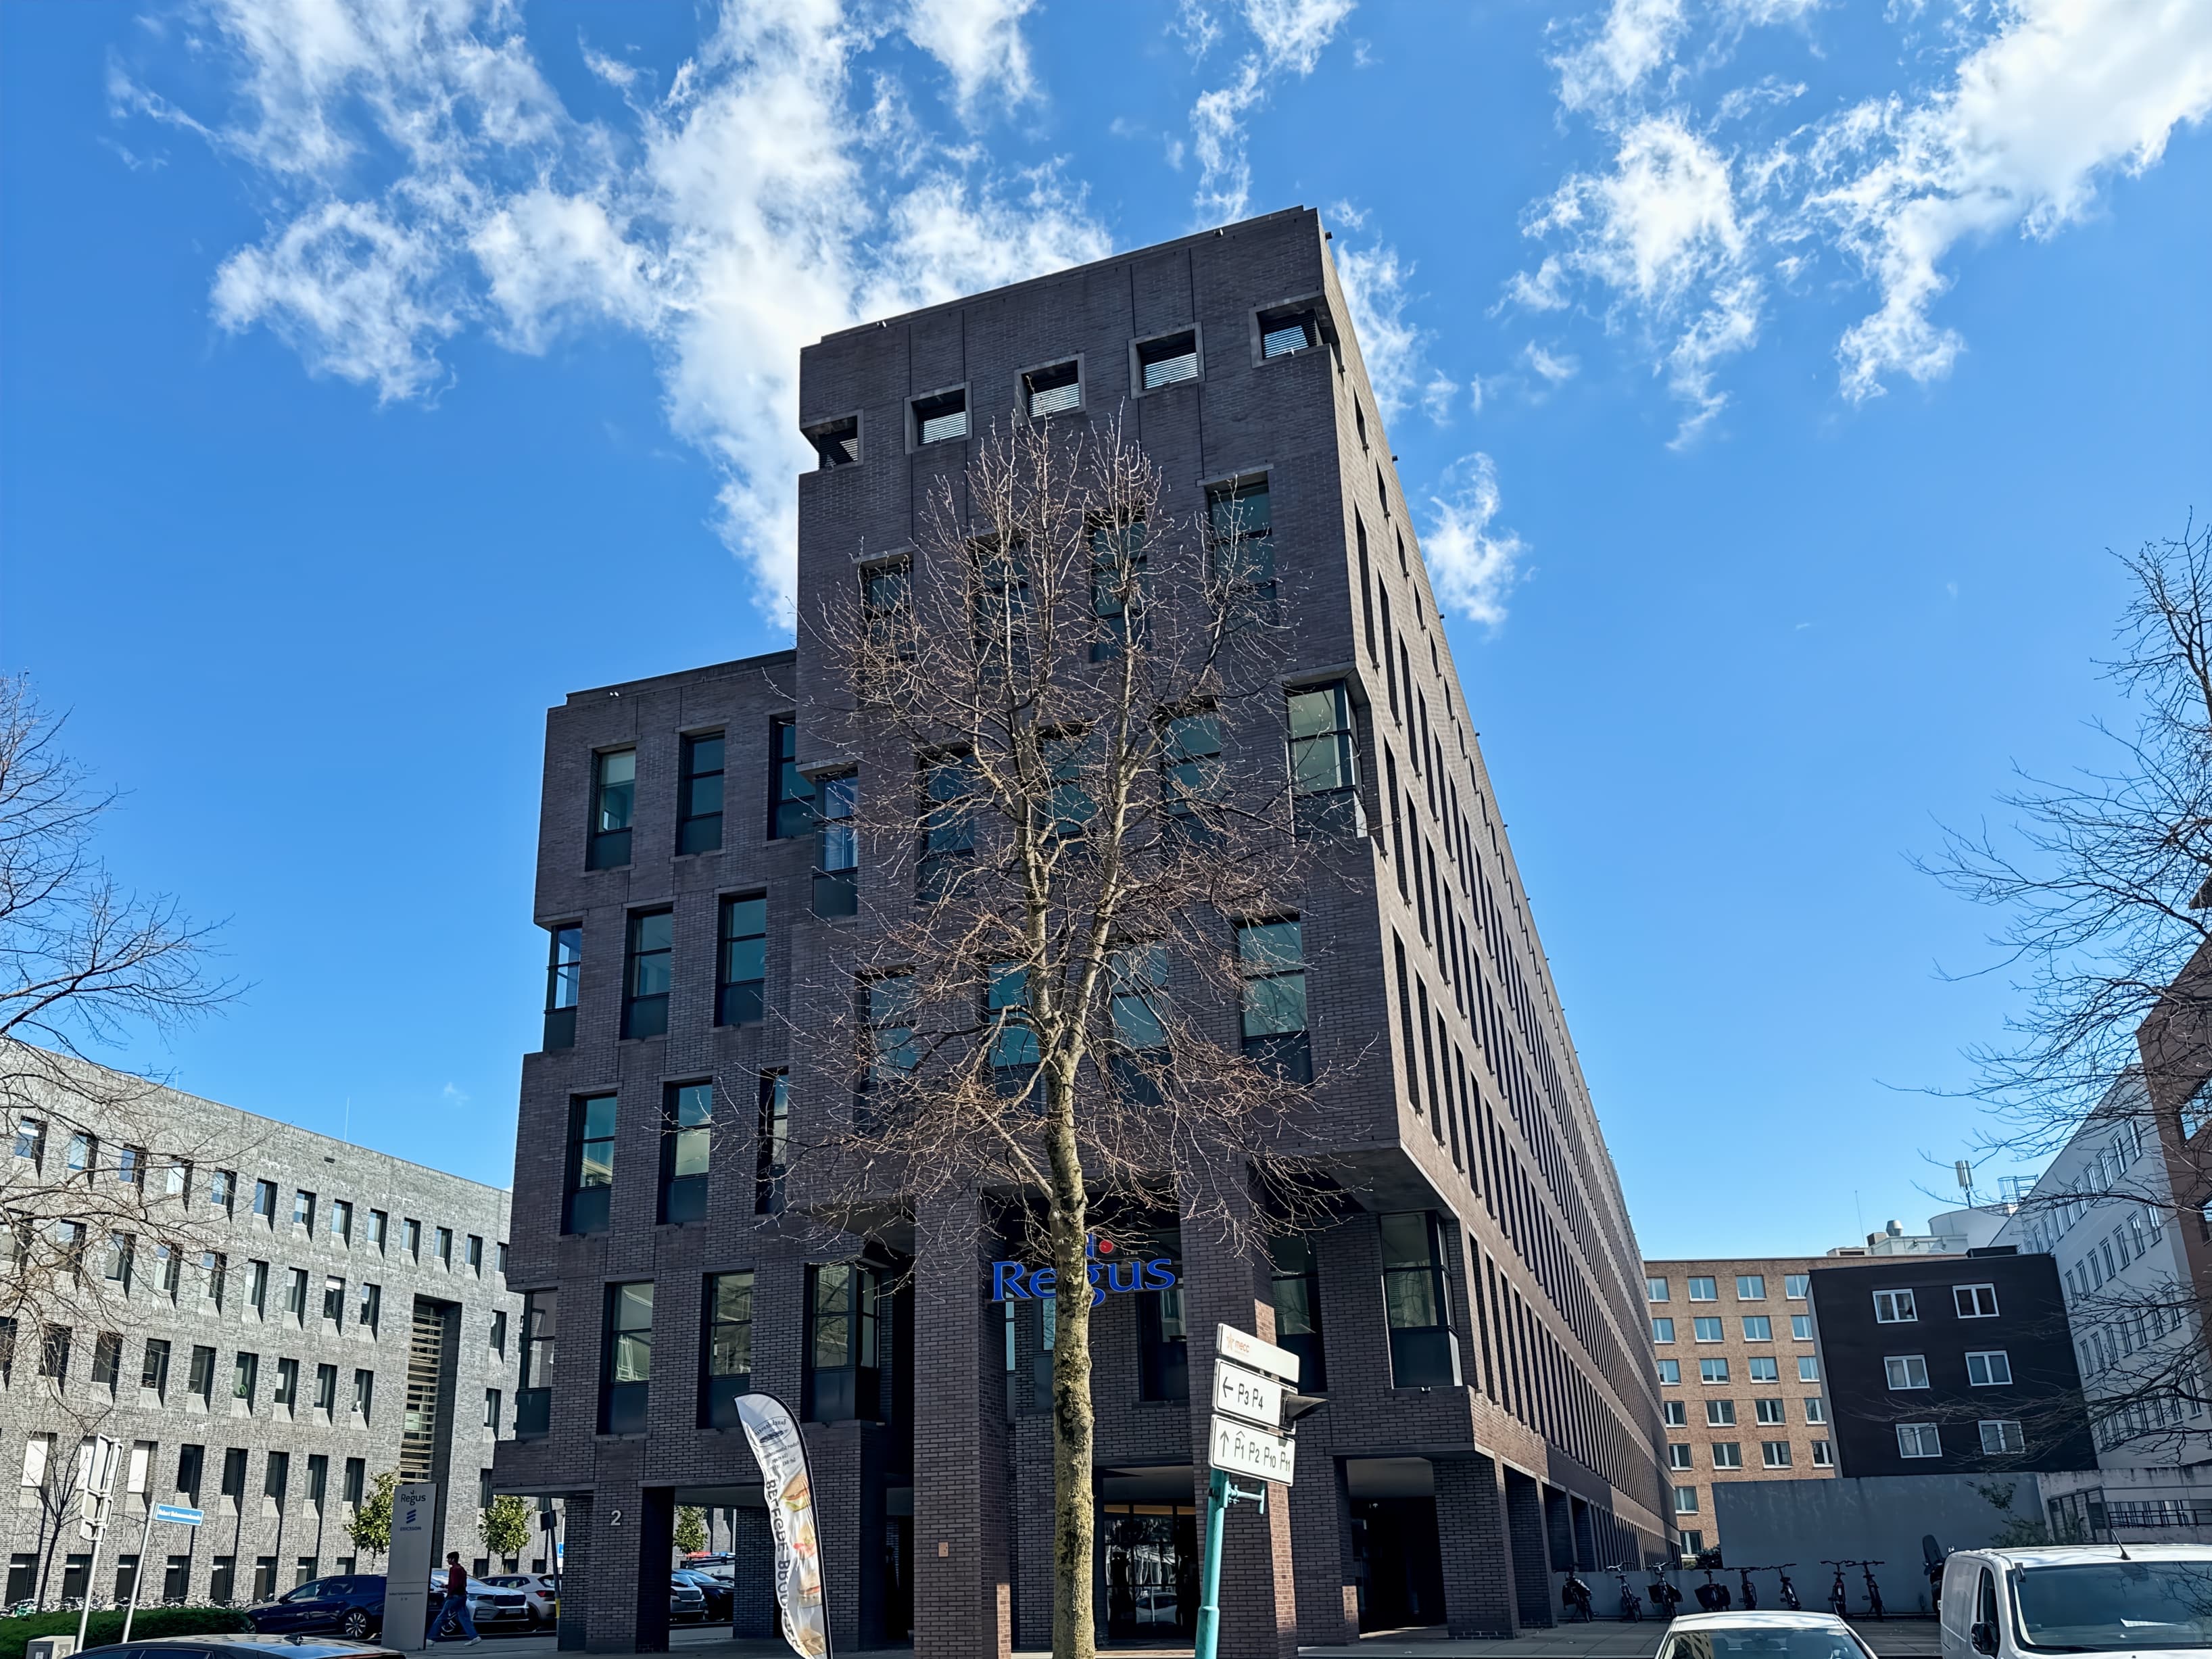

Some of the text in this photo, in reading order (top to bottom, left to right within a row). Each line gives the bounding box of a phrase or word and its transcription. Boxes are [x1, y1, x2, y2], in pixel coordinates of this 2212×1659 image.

[1235, 1341, 1249, 1353] mecc
[1238, 1383, 1263, 1410] P3 P4
[1234, 1437, 1291, 1472] P1 P2 P10 P11
[400, 1493, 427, 1506] Regus
[610, 1510, 621, 1526] 2
